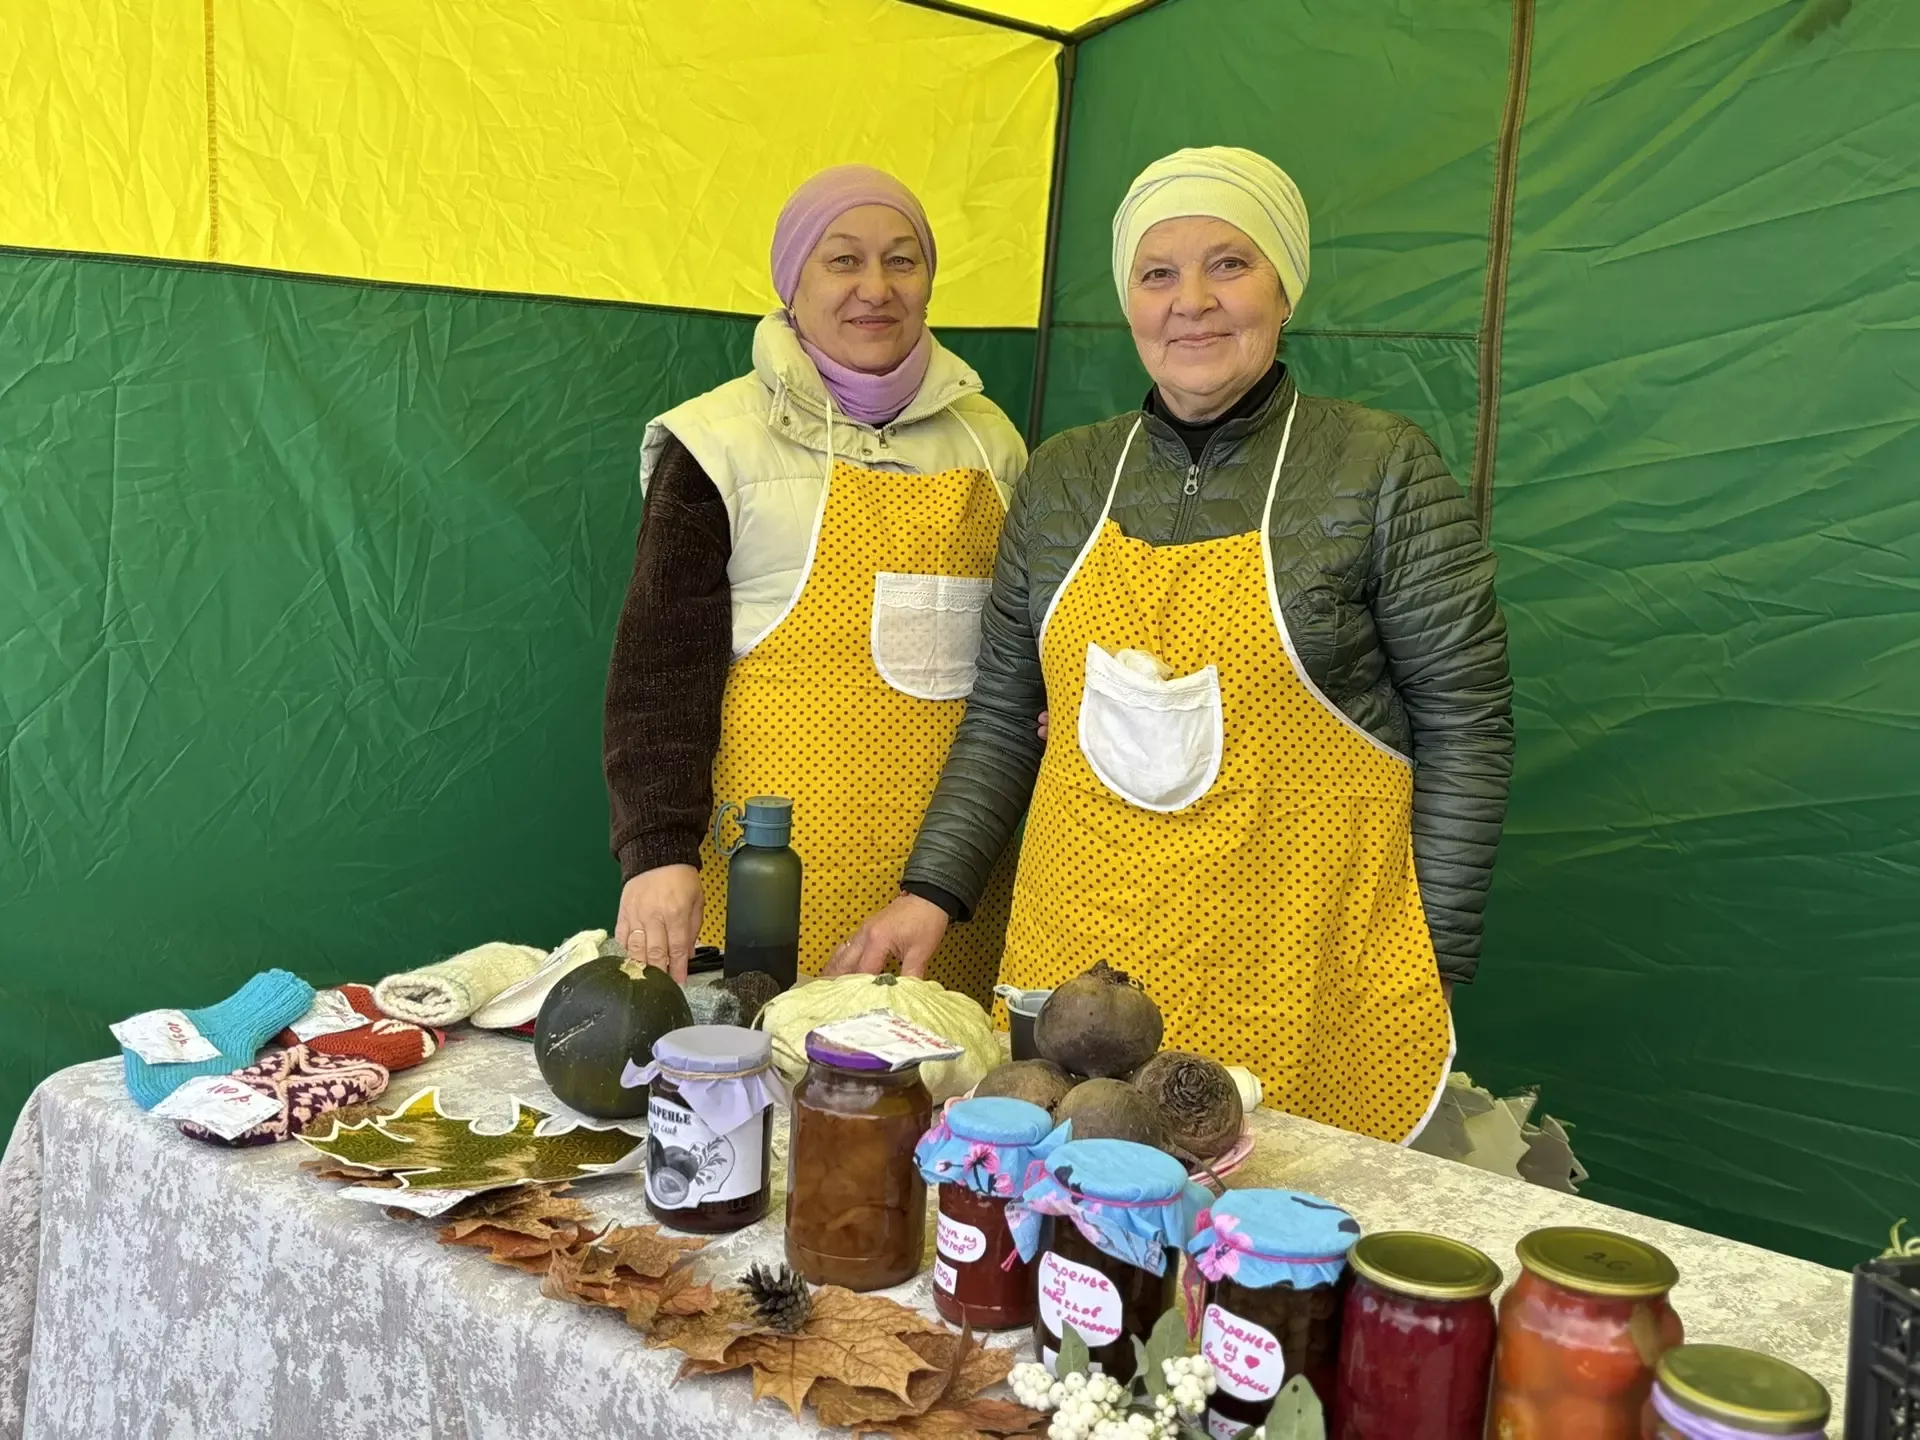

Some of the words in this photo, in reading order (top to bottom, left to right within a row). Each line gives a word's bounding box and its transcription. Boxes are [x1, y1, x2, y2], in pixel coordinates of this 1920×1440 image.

[1044, 1252, 1109, 1292] Варенье
[1053, 1277, 1066, 1296] из
[1208, 1308, 1277, 1356] Варенье
[1223, 1340, 1239, 1363] из
